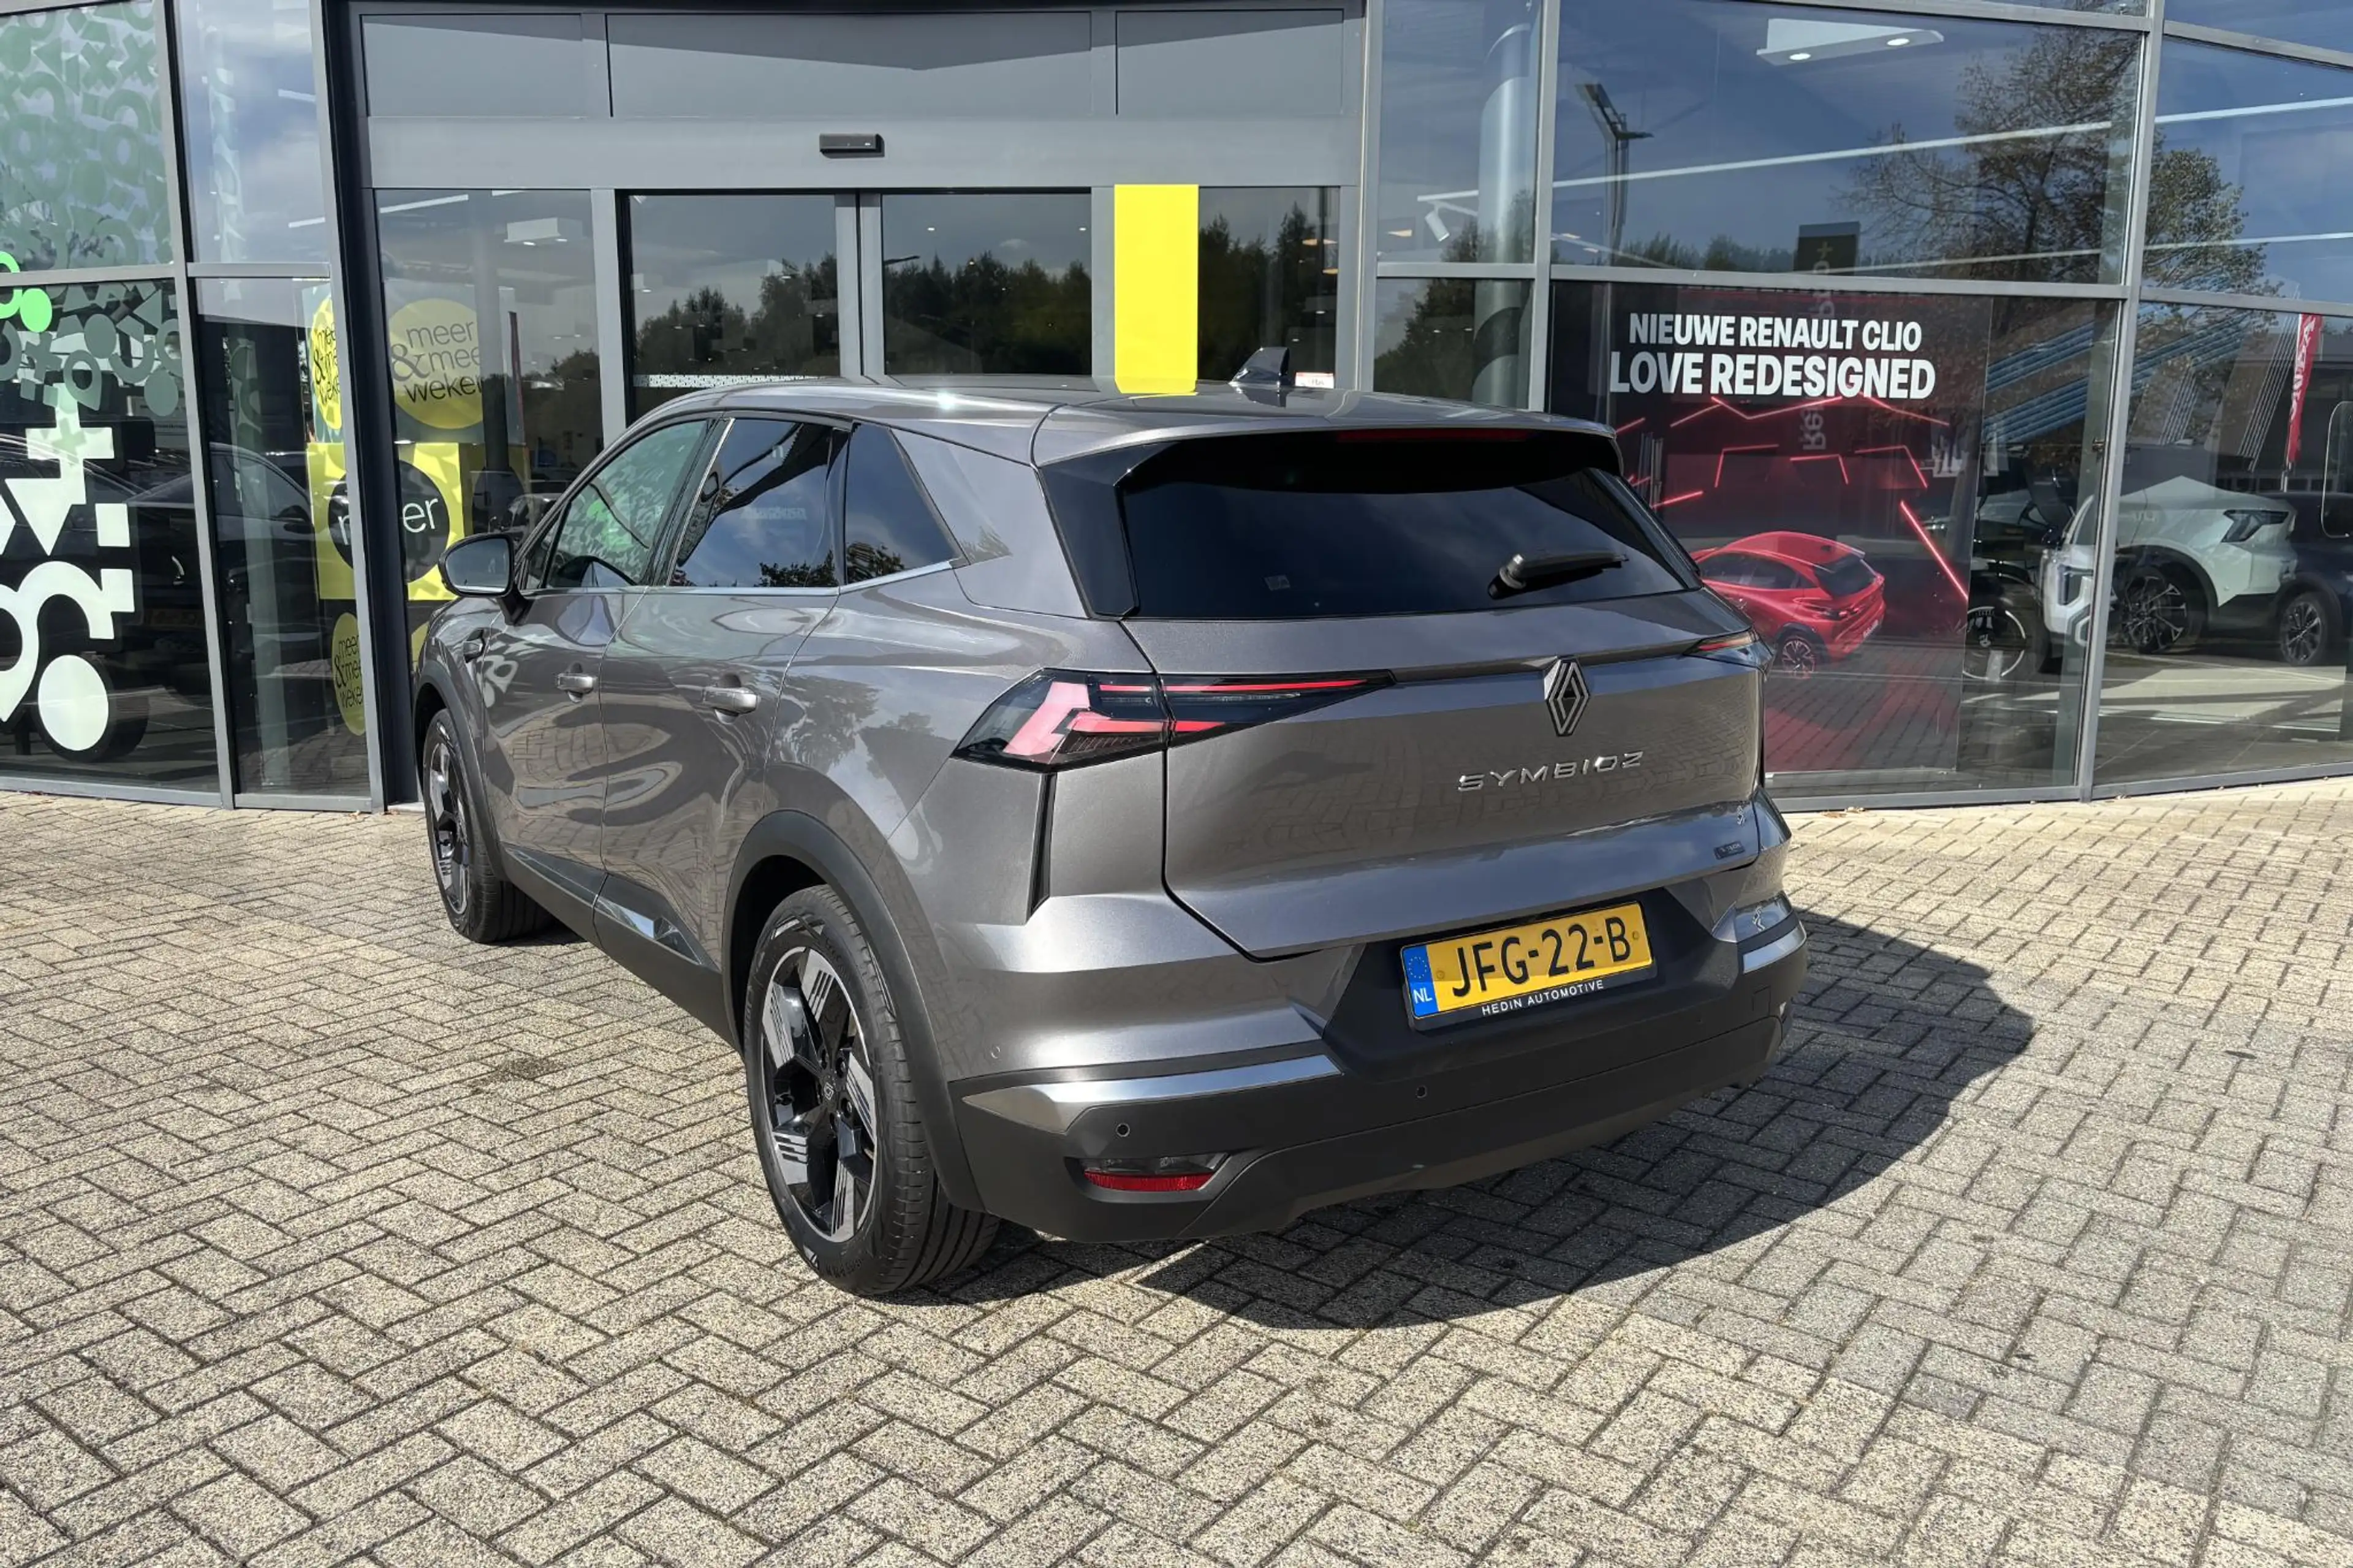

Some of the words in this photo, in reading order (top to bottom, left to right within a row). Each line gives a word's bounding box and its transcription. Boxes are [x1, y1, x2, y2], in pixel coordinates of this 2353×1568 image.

[406, 321, 474, 348] meer
[1630, 312, 1735, 346] NIEUWE
[1740, 316, 1859, 350] RENAULT
[1862, 320, 1922, 352] CLIO
[1609, 350, 1703, 393] LOVE
[1710, 353, 1936, 400] REDESIGNED
[1458, 751, 1643, 791] SYMBIOZ
[1452, 916, 1631, 998] JFG-22-B
[1413, 988, 1433, 1005] NL
[1482, 996, 1523, 1016] HEDIN
[1528, 979, 1604, 1006] AUTOMOTIVE
